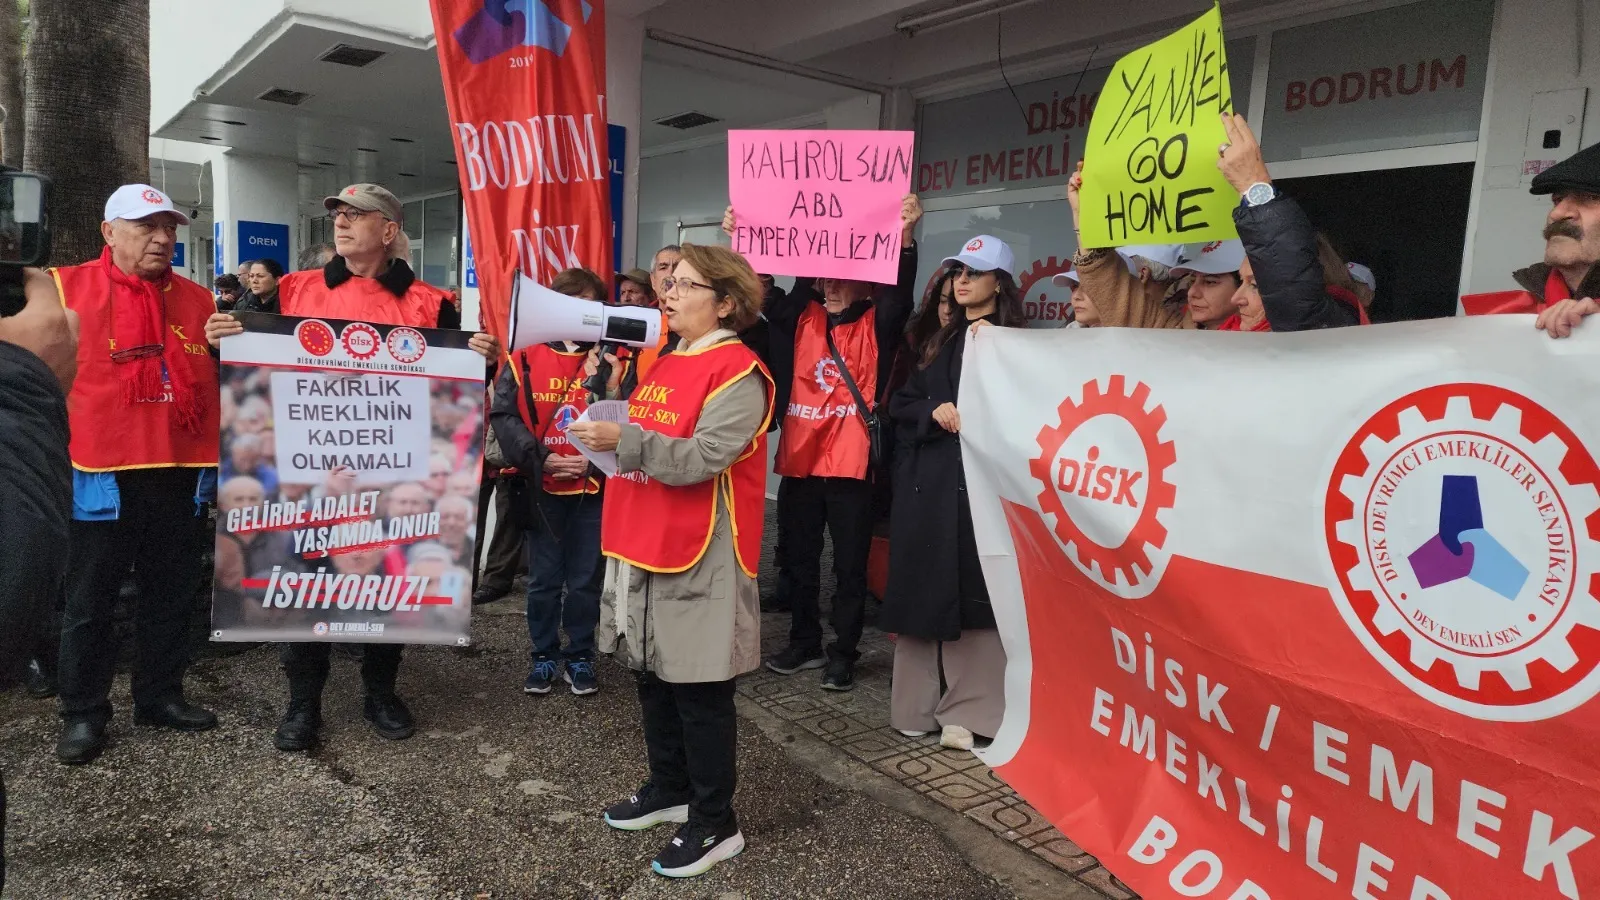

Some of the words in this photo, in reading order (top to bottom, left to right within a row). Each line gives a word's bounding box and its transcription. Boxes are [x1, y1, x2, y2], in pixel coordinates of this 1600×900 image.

[1103, 26, 1233, 146] YANKEE
[1284, 54, 1467, 114] BODRUM
[455, 113, 604, 192] BODRUM
[742, 139, 912, 183] KAHROLSUN
[917, 158, 958, 193] DEV
[966, 134, 1070, 186] EMEKLİ
[1126, 132, 1189, 184] GO
[788, 190, 843, 219] ABD
[1104, 185, 1215, 241] HOME
[248, 236, 278, 247] ÖREN
[1024, 293, 1072, 321] DİSK
[350, 336, 372, 347] DİSK
[296, 376, 402, 397] FAKİRLİK
[288, 401, 412, 422] EMEKLİNİN
[308, 425, 394, 446] KADERİ
[292, 452, 412, 471] OLMAMALI
[1057, 445, 1143, 509] DİSK
[1424, 440, 1537, 492] EMEKLİLER
[226, 500, 307, 533] GELİRDE
[311, 490, 380, 522] ADALET
[1372, 448, 1422, 533] DEVRİMCİ
[293, 518, 383, 558] YAŞAMDA
[388, 511, 441, 540] ONUR
[1531, 490, 1570, 607] SENDİKASI
[1374, 538, 1399, 583] DİSK
[262, 565, 430, 612] İSTİYORUZ!
[1412, 608, 1439, 632] DEV
[1439, 625, 1494, 648] EMEKLİ
[1494, 624, 1523, 646] SEN
[1110, 626, 1234, 734] DİSK
[1313, 720, 1596, 900] EMEK
